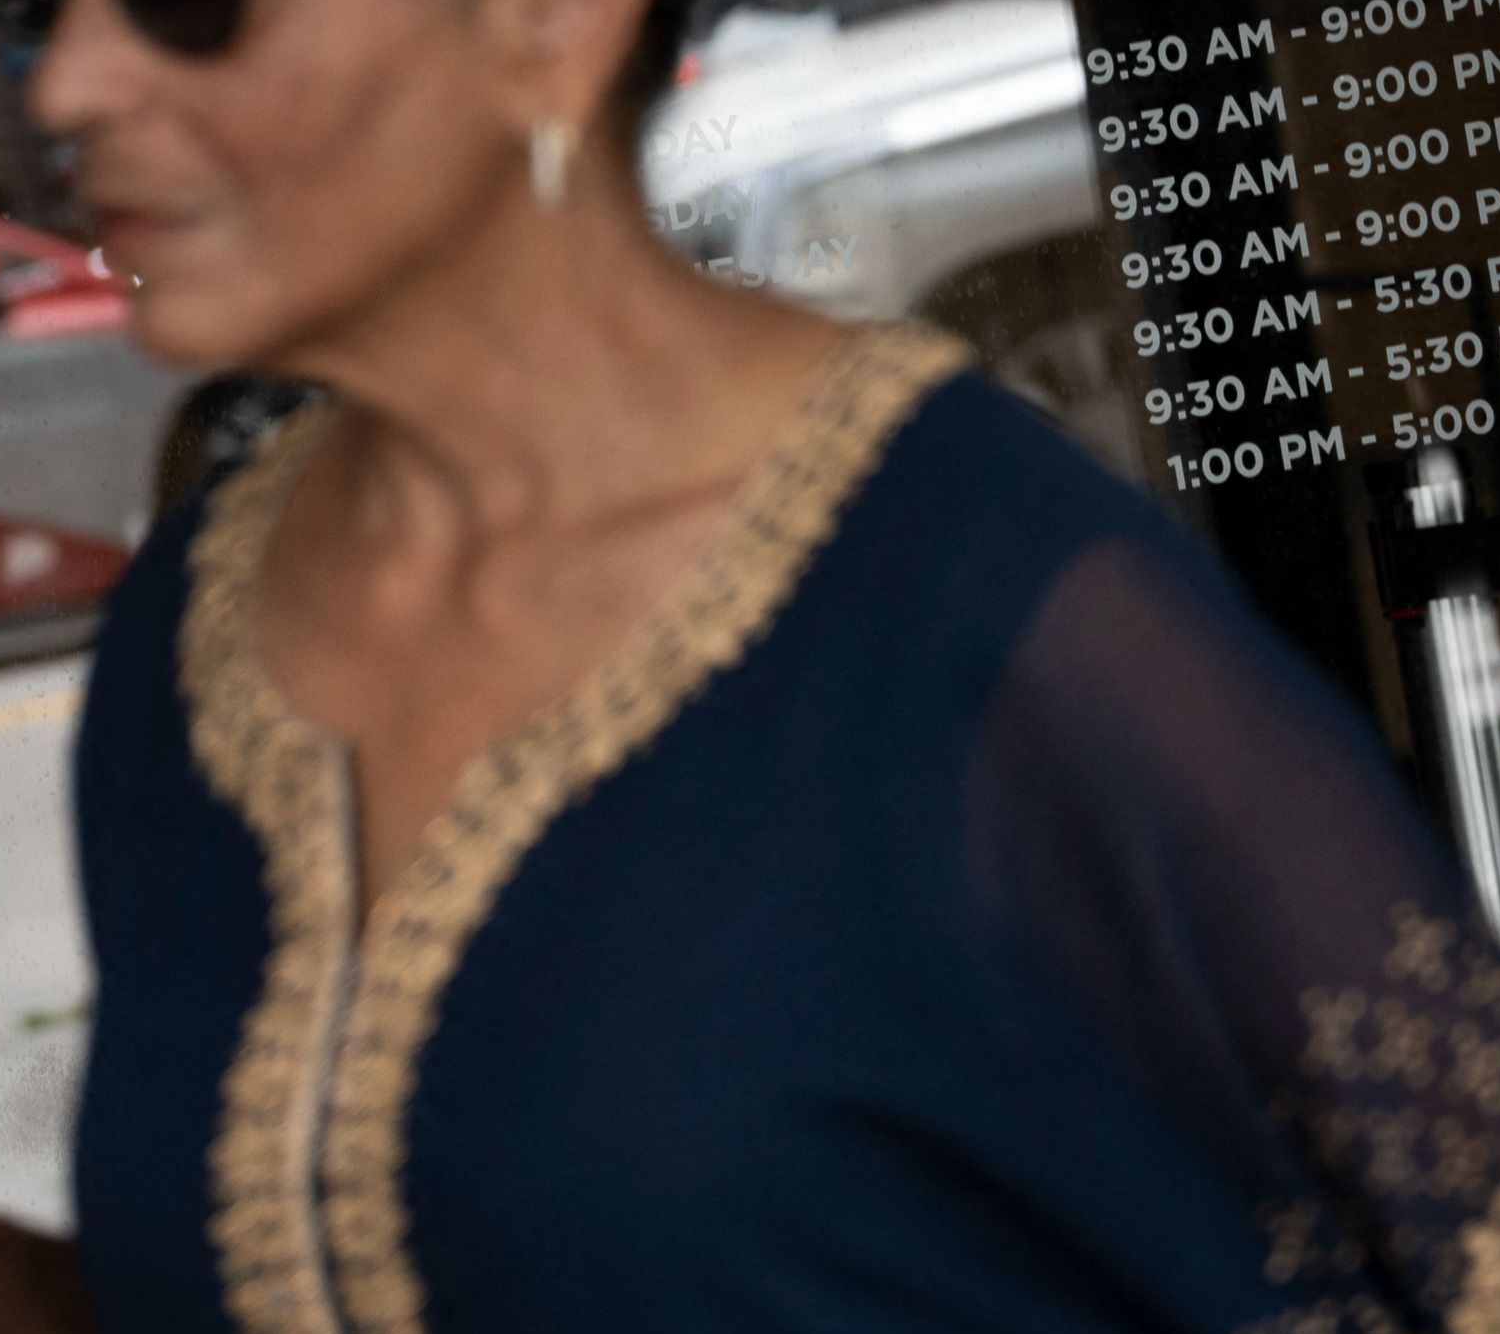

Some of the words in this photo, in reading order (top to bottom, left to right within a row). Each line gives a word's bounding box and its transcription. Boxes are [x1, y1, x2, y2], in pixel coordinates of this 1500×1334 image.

[649, 115, 738, 164] DAY
[1086, 34, 1188, 85] 9:30
[1205, 18, 1276, 66] AM
[1291, 27, 1306, 39] -
[1098, 102, 1200, 153] 9:30
[1216, 85, 1288, 134] AM
[1302, 95, 1318, 106] -
[1332, 60, 1438, 111] 9:00
[694, 234, 859, 288] ESDAY
[1109, 170, 1212, 221] 9:30
[1228, 153, 1299, 202] AM
[1314, 163, 1329, 174] -
[1344, 128, 1450, 179] 9:00
[1121, 238, 1223, 290] 9:30
[1239, 221, 1311, 270] AM
[1325, 231, 1341, 242] -
[1355, 195, 1461, 247] 9:00
[1133, 306, 1235, 357] 9:30
[1251, 289, 1322, 338] AM
[1337, 299, 1352, 310] -
[1374, 263, 1472, 313] 5:30
[1144, 374, 1246, 425] 9:30
[1263, 357, 1334, 405] AM
[1348, 367, 1364, 378] -
[1385, 331, 1484, 381] 5:30
[1166, 441, 1264, 492] 1:00
[1278, 424, 1347, 472] PM
[1360, 434, 1377, 446] -
[1392, 398, 1495, 450] 5:00
